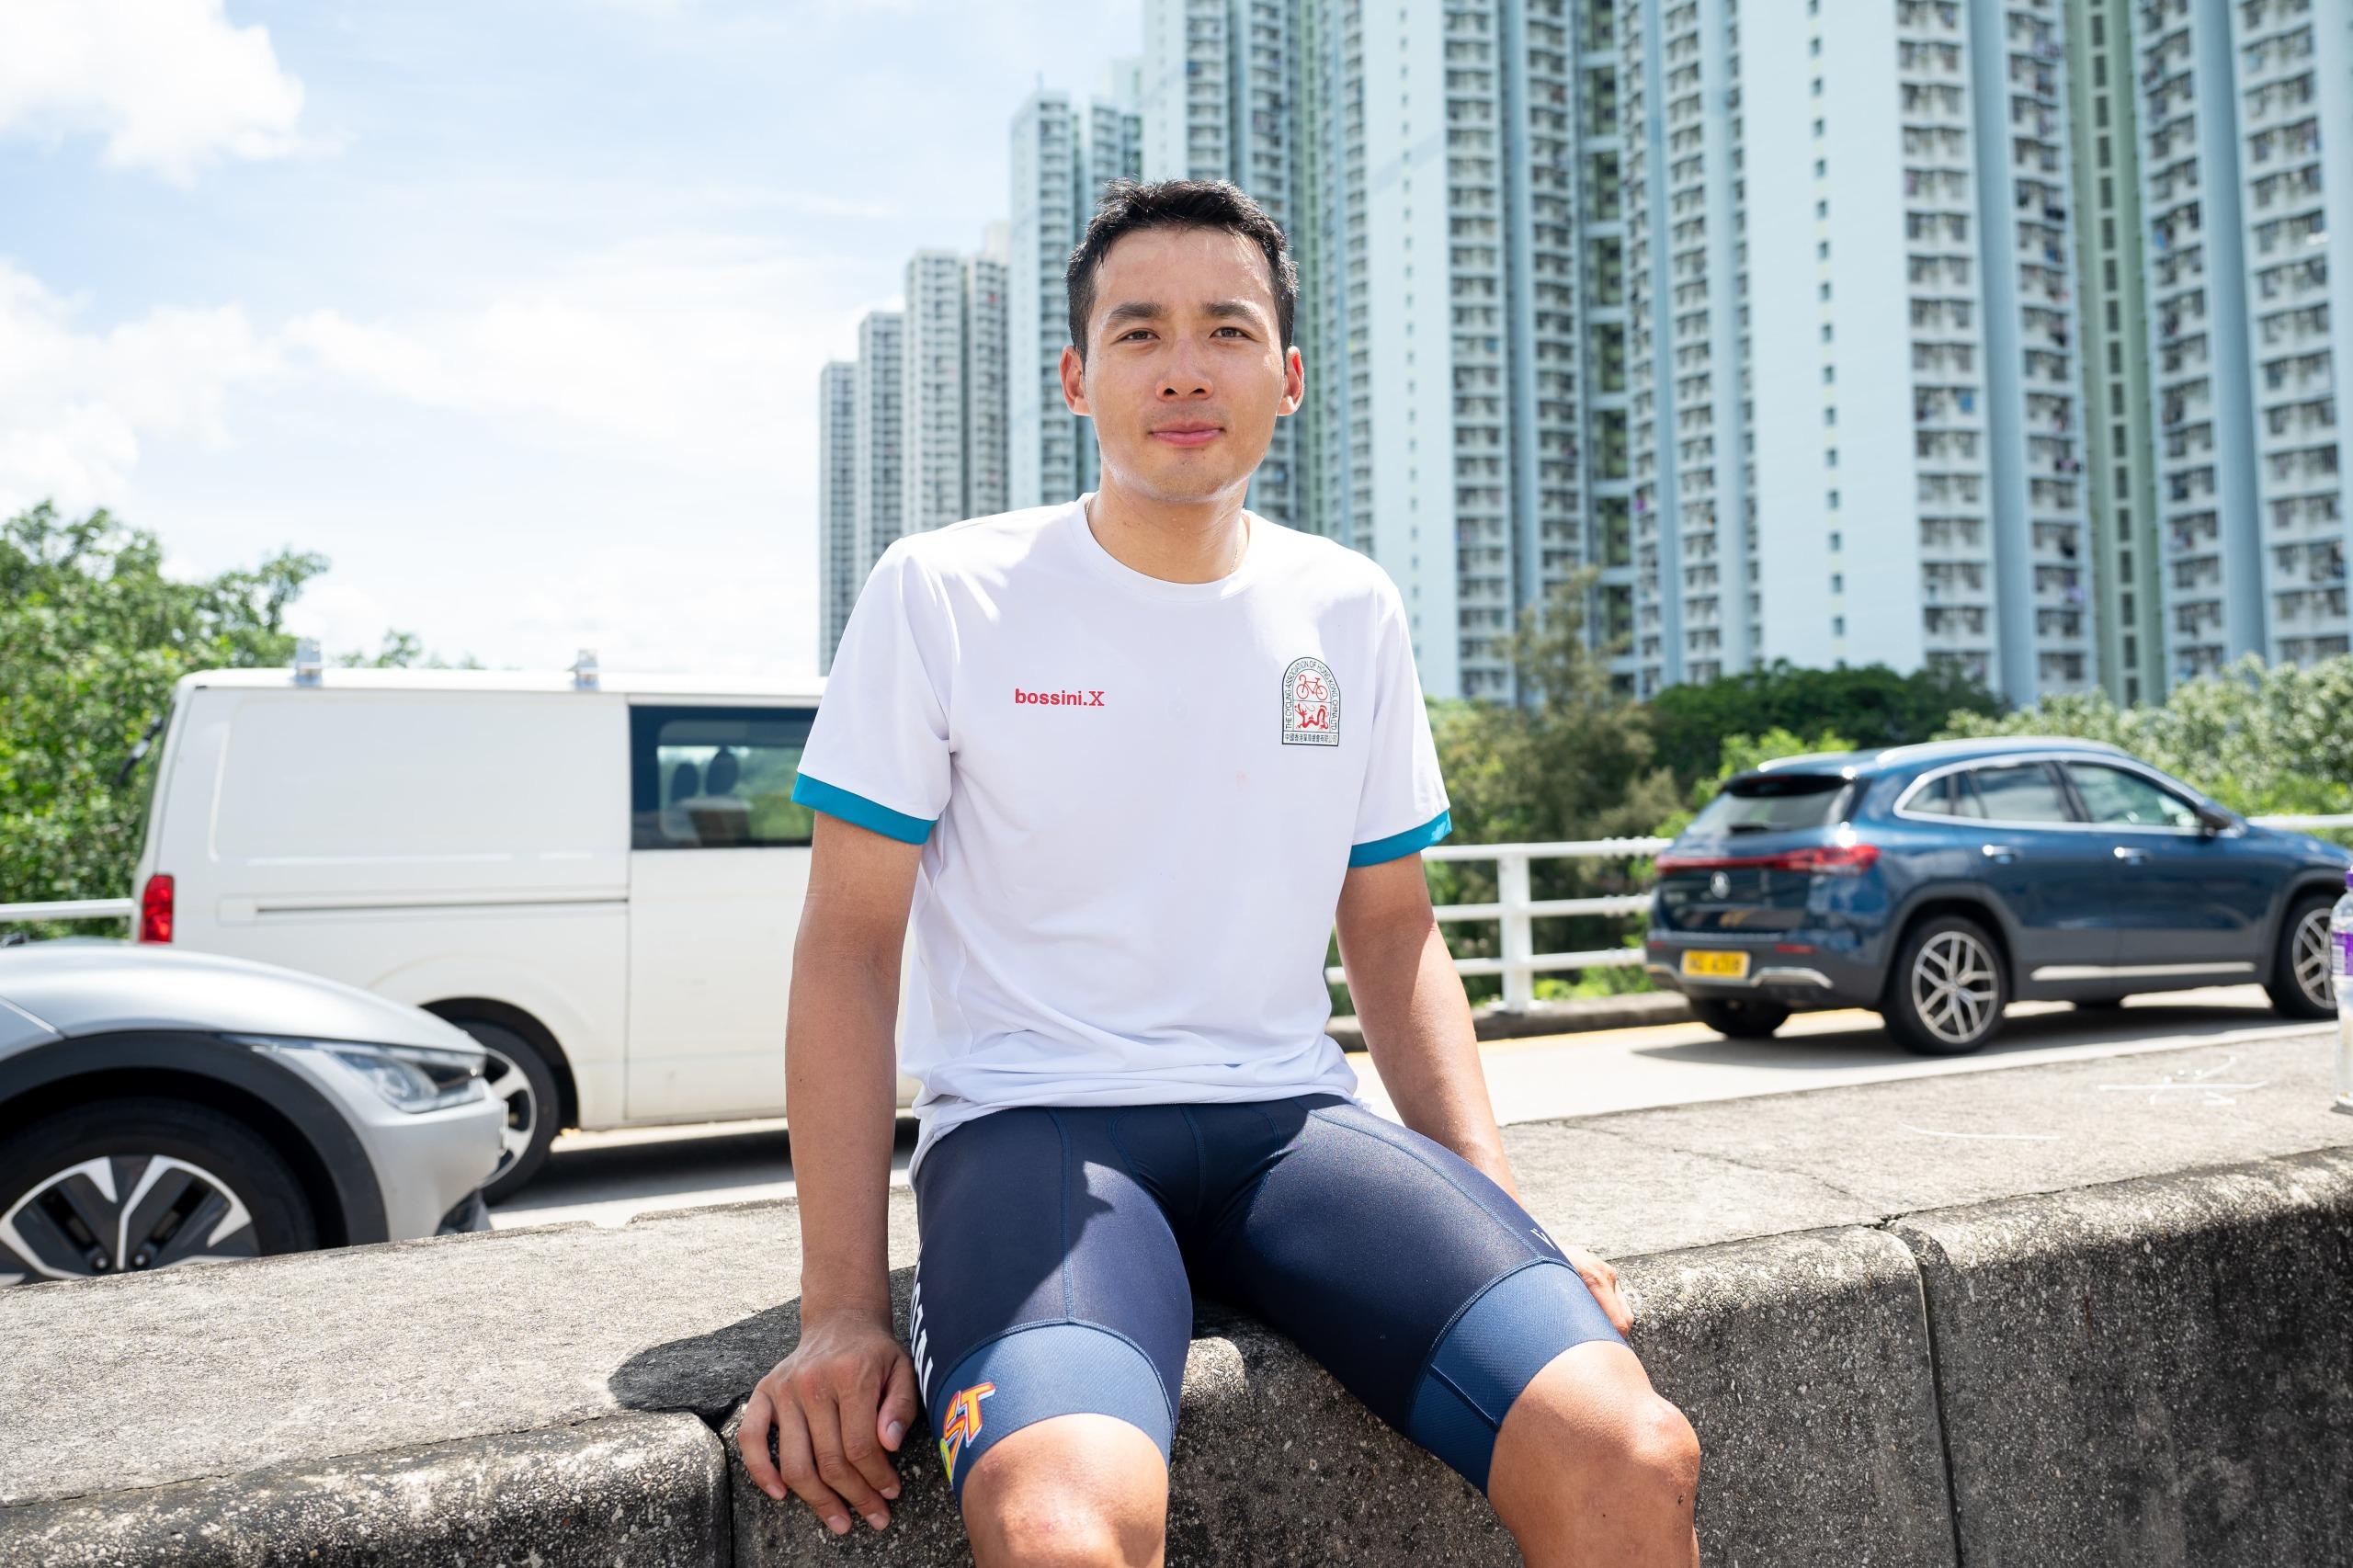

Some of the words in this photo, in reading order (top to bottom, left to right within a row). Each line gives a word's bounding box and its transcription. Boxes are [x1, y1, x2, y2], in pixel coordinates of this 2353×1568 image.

[1285, 661, 1309, 688] ASSOCIATION
[1310, 660, 1316, 668] OF
[1317, 665, 1331, 680] HONG
[1015, 688, 1105, 706] bossini.X
